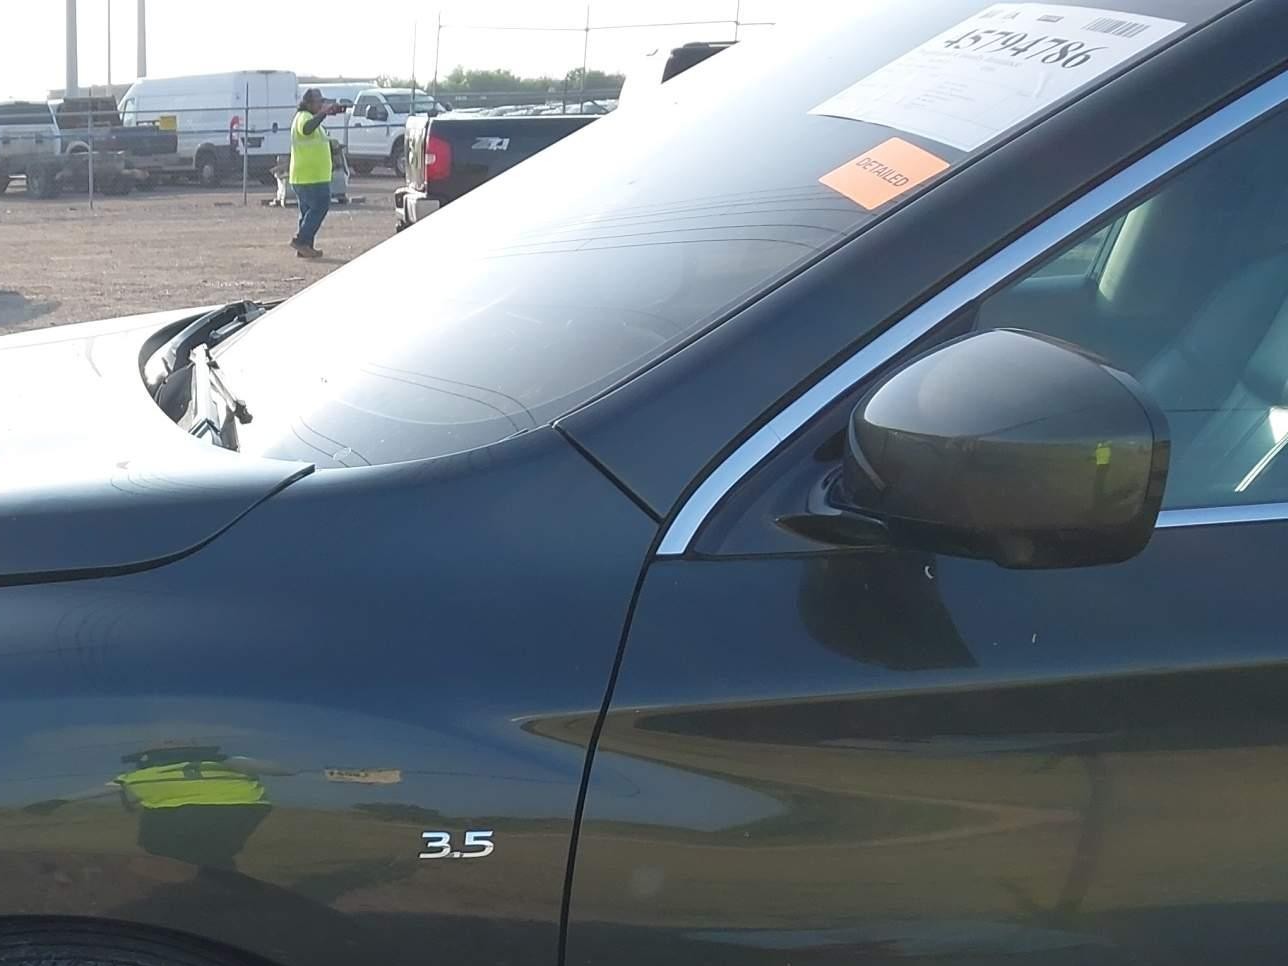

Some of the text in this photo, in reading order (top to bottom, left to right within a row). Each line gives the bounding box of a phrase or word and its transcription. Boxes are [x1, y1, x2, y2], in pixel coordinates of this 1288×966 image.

[944, 28, 1109, 69] 45794786
[855, 157, 910, 187] DETAILED
[419, 830, 494, 858] 3.5
